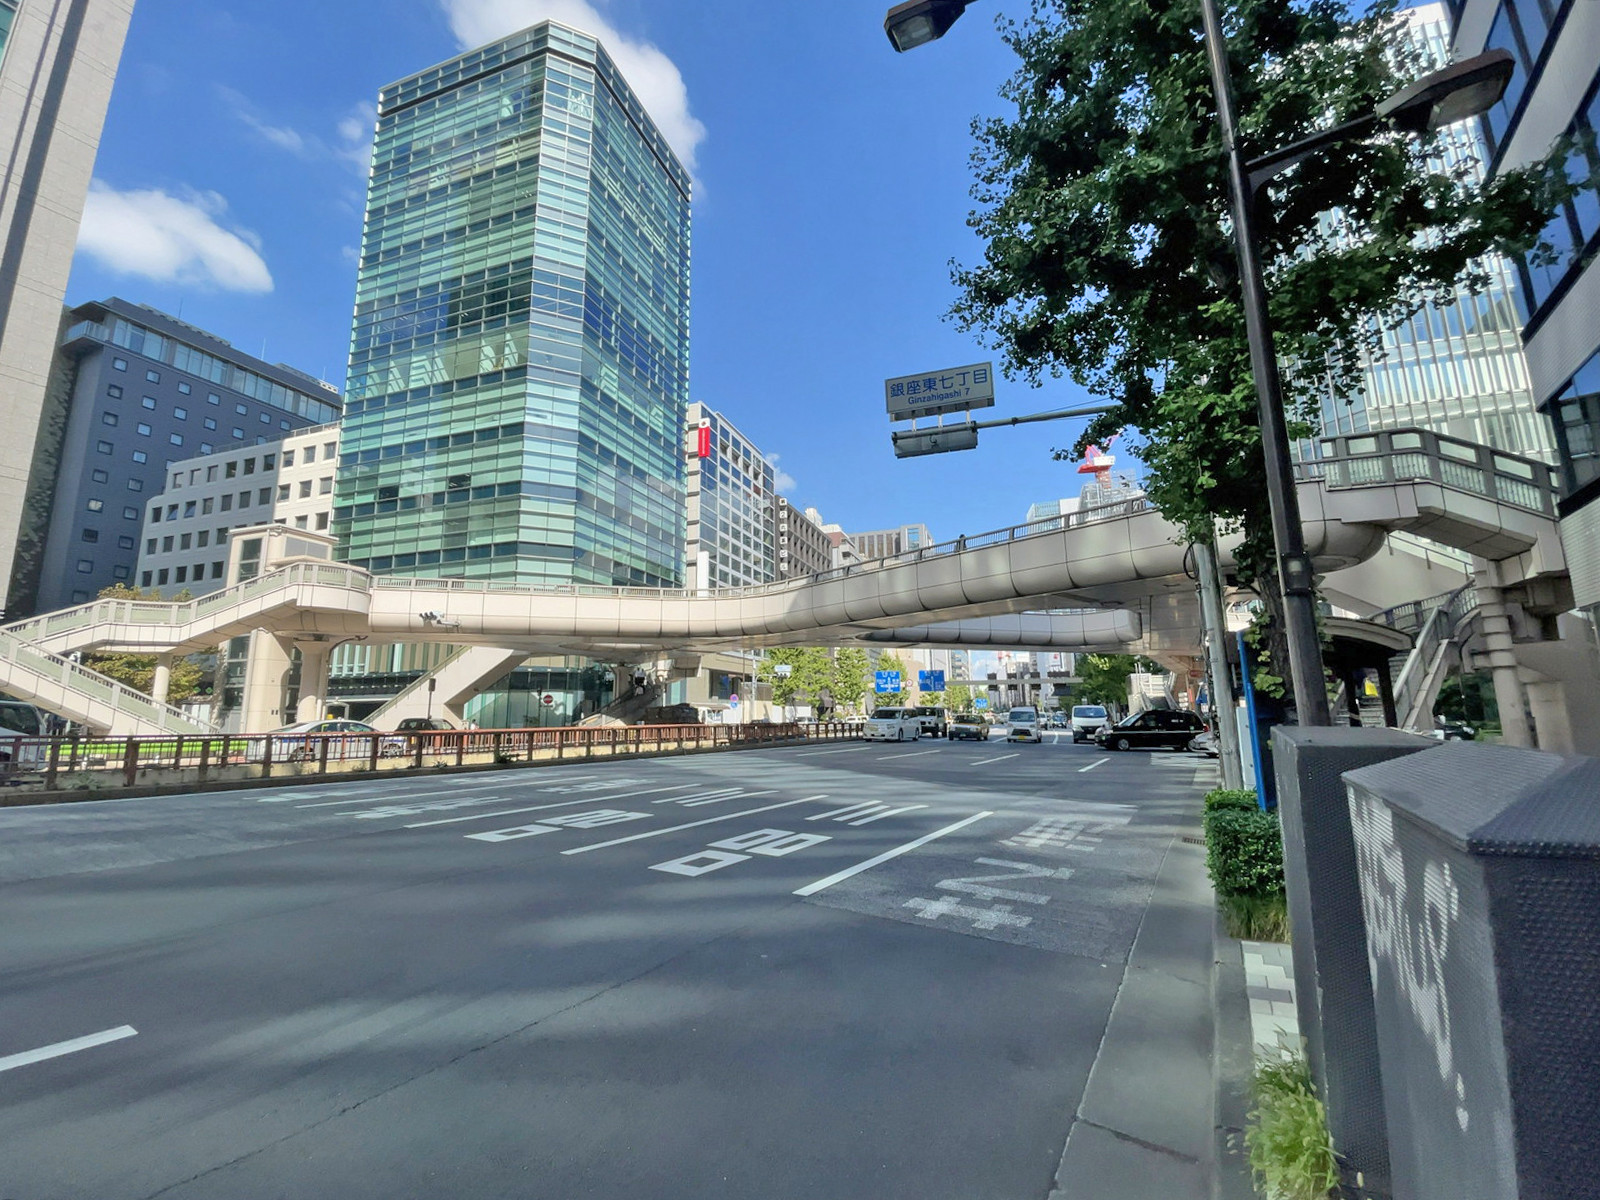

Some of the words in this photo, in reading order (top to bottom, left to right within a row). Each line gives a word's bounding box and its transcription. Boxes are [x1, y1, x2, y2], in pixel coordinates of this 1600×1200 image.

[890, 369, 987, 397] 銀座東七丁目
[908, 390, 961, 404] Ginzahigashi
[965, 387, 970, 396] 7
